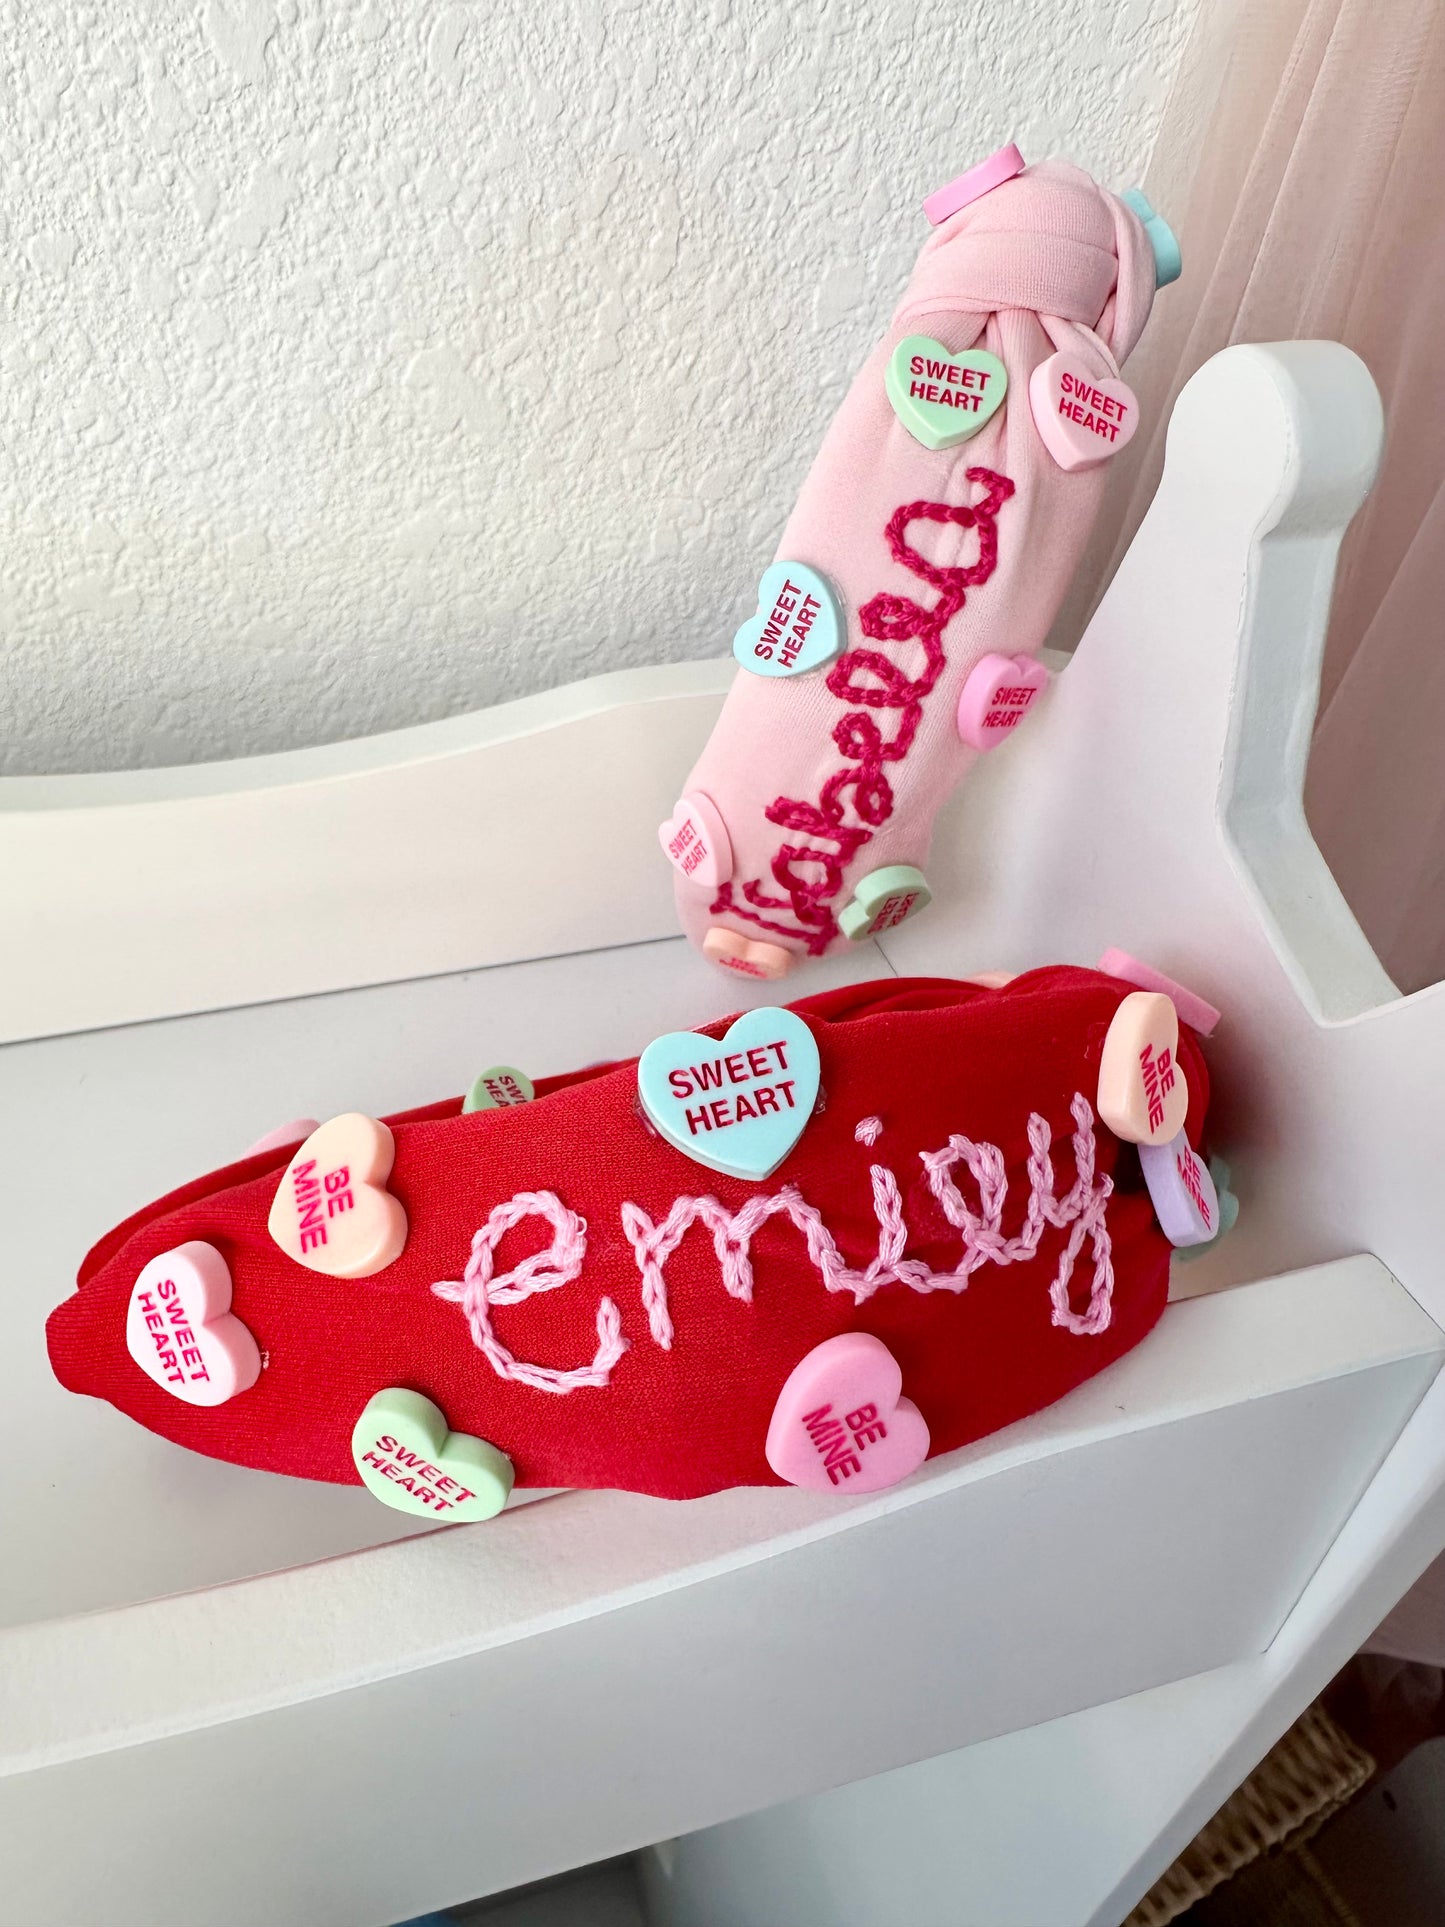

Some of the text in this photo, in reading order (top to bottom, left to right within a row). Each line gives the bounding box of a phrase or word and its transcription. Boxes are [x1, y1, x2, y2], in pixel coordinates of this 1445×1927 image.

[910, 356, 991, 391] SWEET
[910, 381, 983, 412] HEART
[1060, 372, 1127, 422] SWEET
[1058, 398, 1120, 442] HEART
[754, 579, 801, 660] SWEET
[777, 594, 821, 668] HEART
[982, 711, 1023, 727] HEART
[992, 687, 1037, 705] SWEET
[668, 819, 698, 860] SWEET
[680, 840, 708, 877] HEART
[668, 1040, 789, 1098] SWEET
[1139, 1043, 1164, 1135] MINE
[1157, 1048, 1175, 1098] BE
[685, 1080, 795, 1135] HEART
[293, 1159, 327, 1253] MINE
[323, 1165, 354, 1218] BE
[431, 1091, 1114, 1394] emily
[137, 1291, 185, 1385] HEART
[157, 1279, 211, 1383] SWEET
[802, 1404, 862, 1487] MINE
[844, 1402, 888, 1452] BE
[362, 1451, 454, 1512] HEART
[376, 1434, 477, 1503] SWEET
